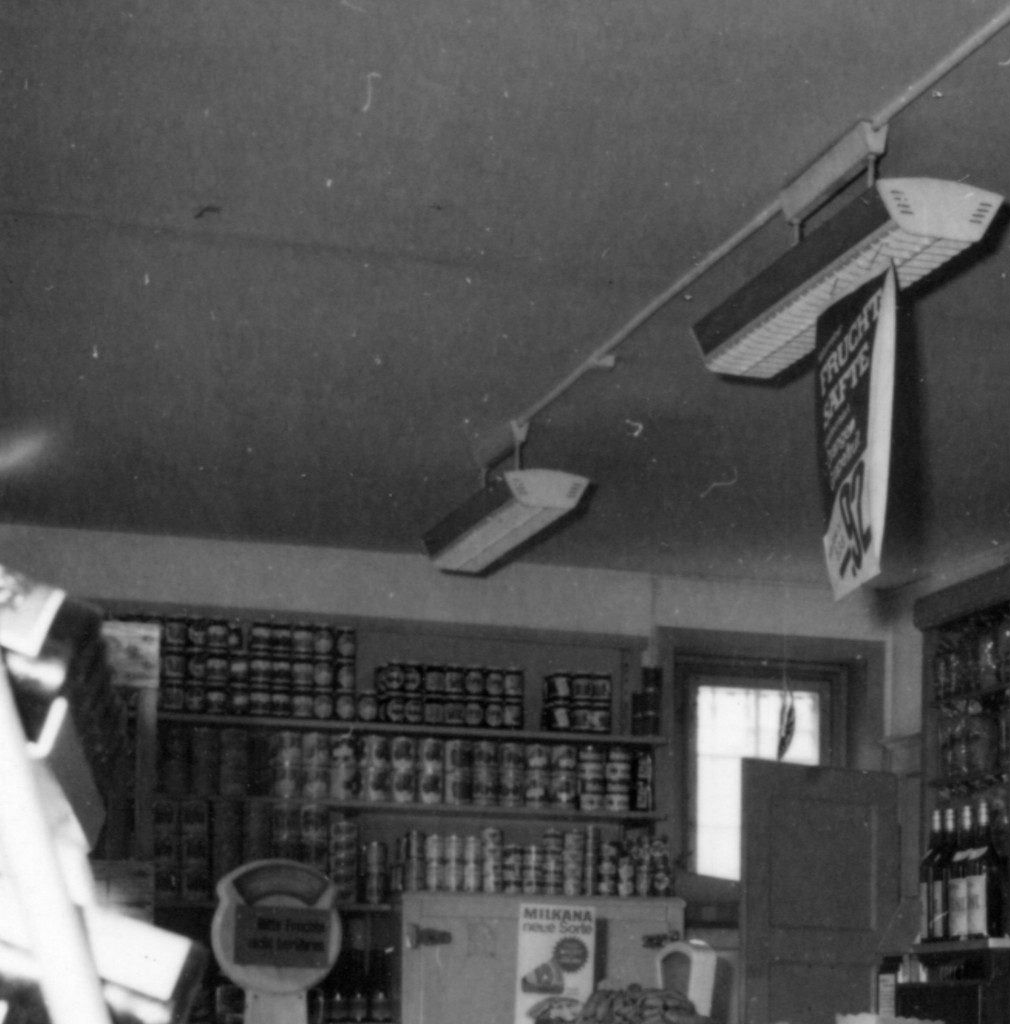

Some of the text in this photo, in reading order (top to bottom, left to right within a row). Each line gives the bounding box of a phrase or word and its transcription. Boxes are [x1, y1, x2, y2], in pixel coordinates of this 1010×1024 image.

[523, 907, 593, 922] MILKANA
[523, 921, 593, 935] neue Sorte
